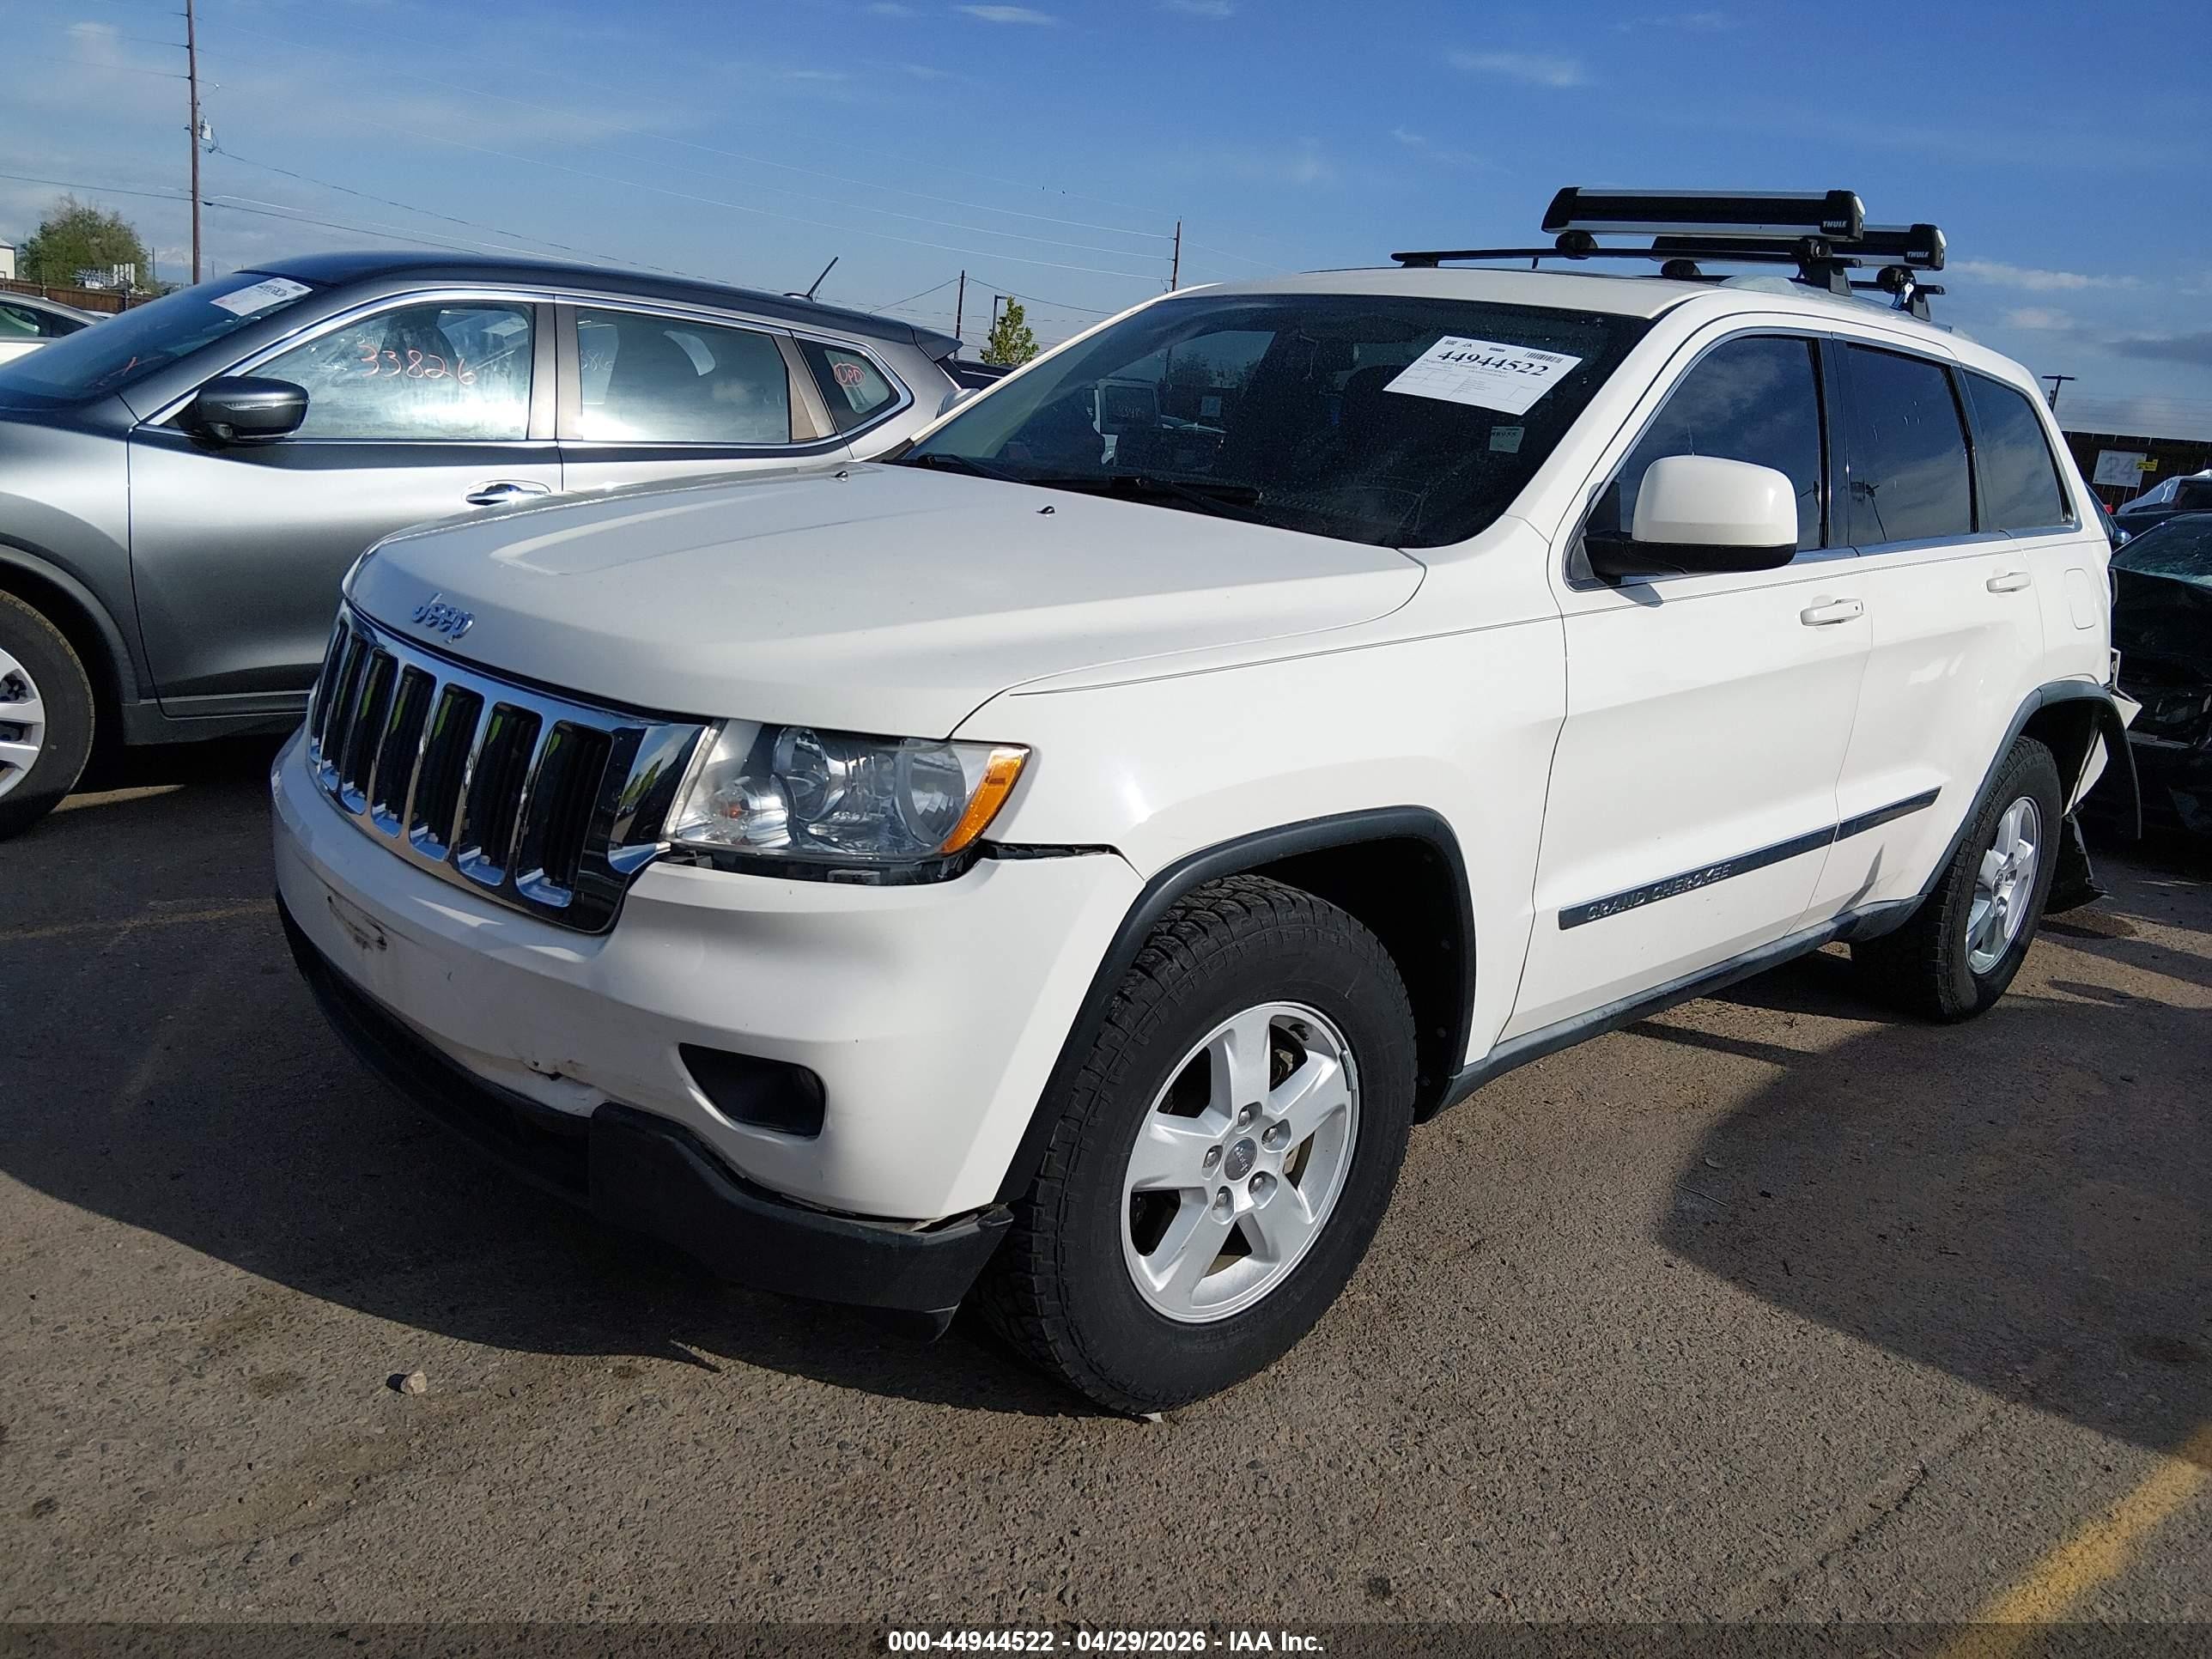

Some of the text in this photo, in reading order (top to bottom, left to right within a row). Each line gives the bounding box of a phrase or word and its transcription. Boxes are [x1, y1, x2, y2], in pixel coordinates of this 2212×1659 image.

[1822, 220, 1847, 228] THULE
[356, 344, 476, 386] 33826
[1437, 349, 1549, 376] 44944522
[2100, 456, 2136, 481] 24
[412, 592, 475, 645] Jeep
[1587, 863, 1732, 921] GRAND CHEROKEE
